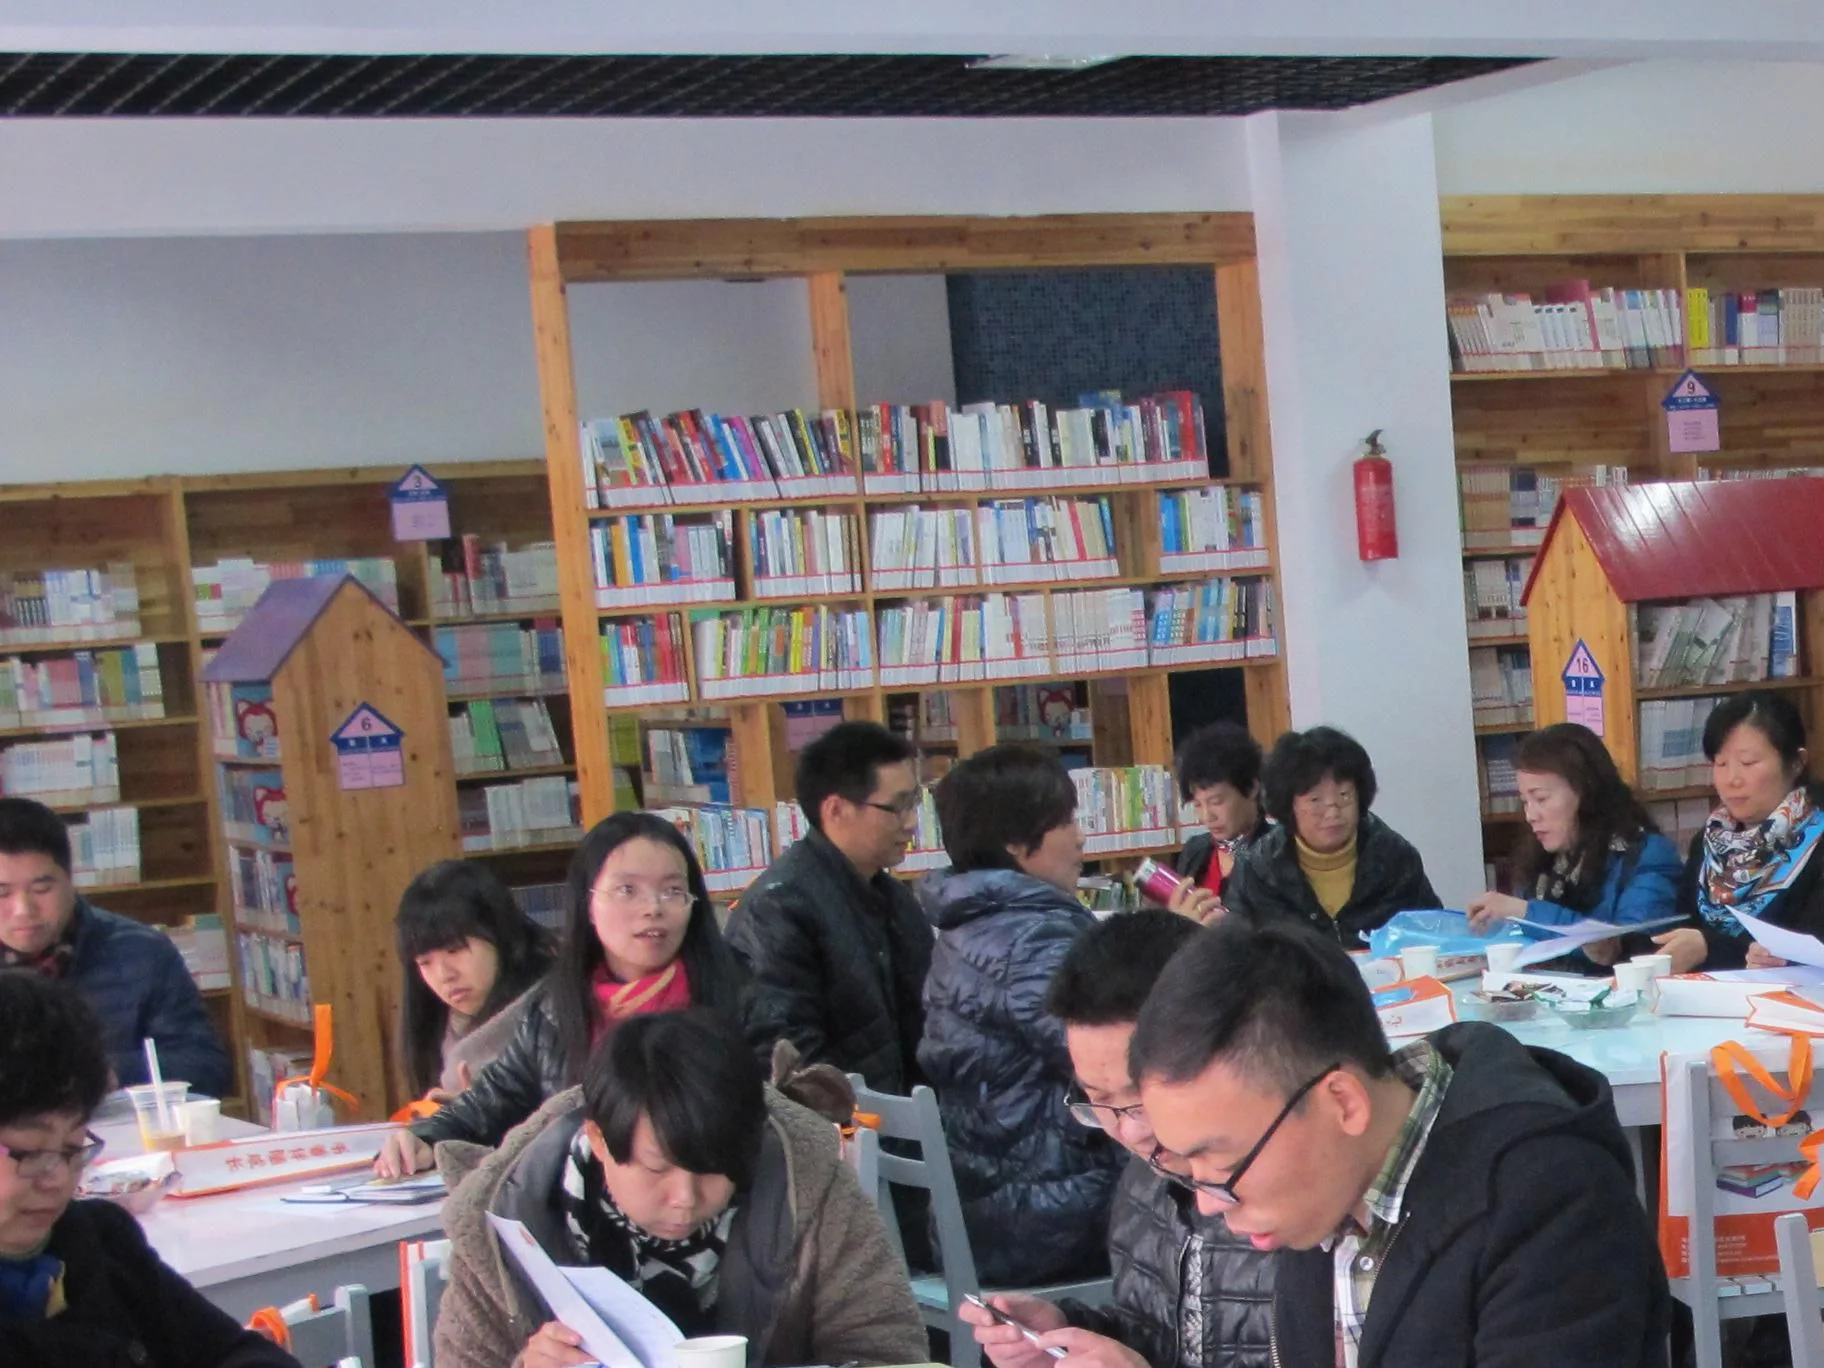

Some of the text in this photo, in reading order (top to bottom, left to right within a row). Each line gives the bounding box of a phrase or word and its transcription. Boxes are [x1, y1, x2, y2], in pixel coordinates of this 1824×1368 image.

[1687, 380, 1695, 395] 9
[1576, 658, 1589, 674] 16
[361, 717, 372, 731] 6
